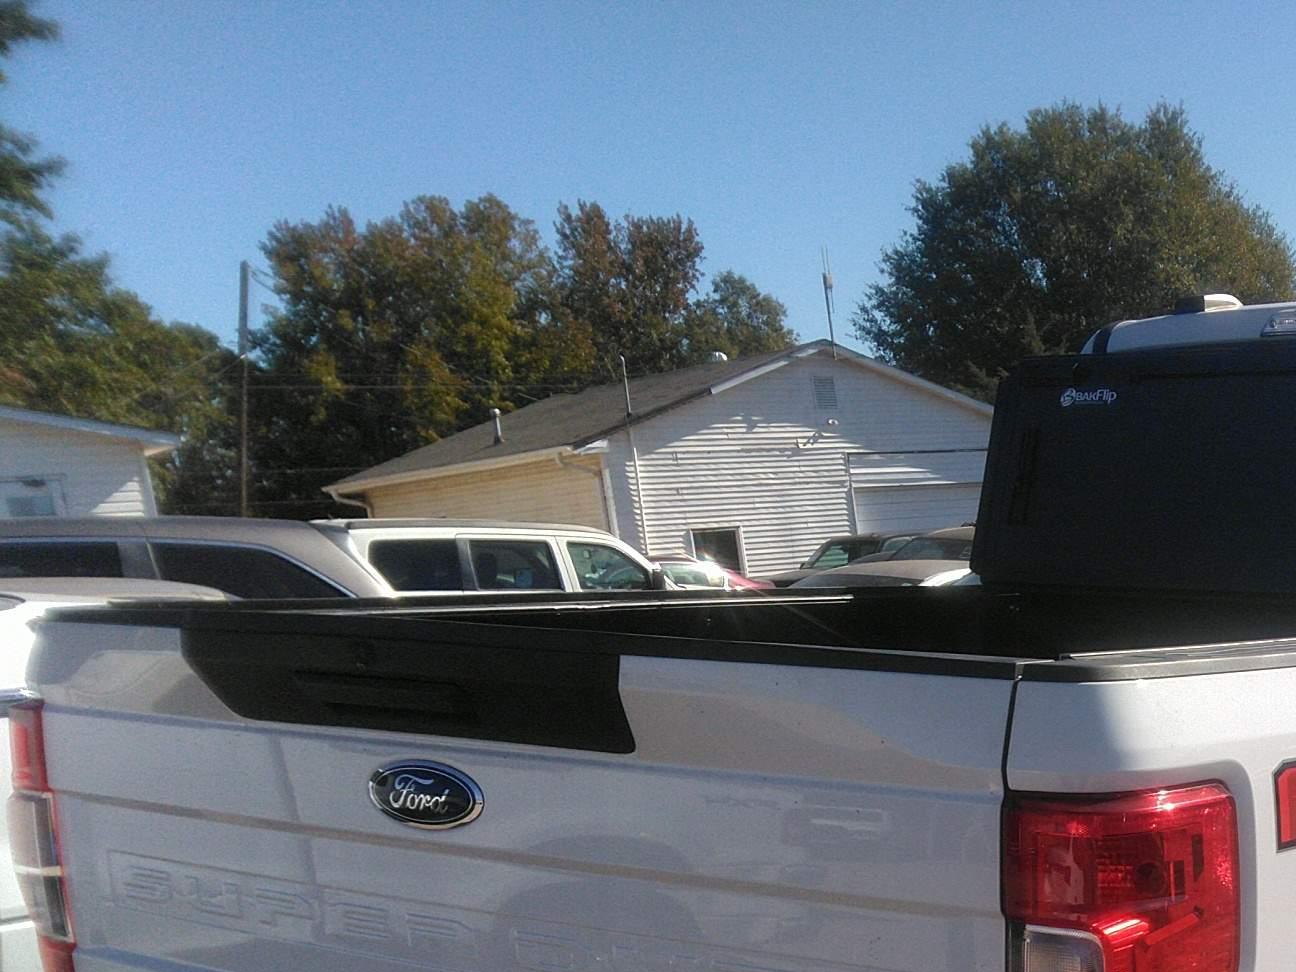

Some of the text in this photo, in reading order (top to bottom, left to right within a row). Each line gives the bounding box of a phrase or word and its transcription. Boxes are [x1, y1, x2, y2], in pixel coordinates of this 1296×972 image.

[1075, 389, 1117, 404] BAKFlip
[389, 773, 451, 814] Ford
[122, 863, 481, 956] SUPER
